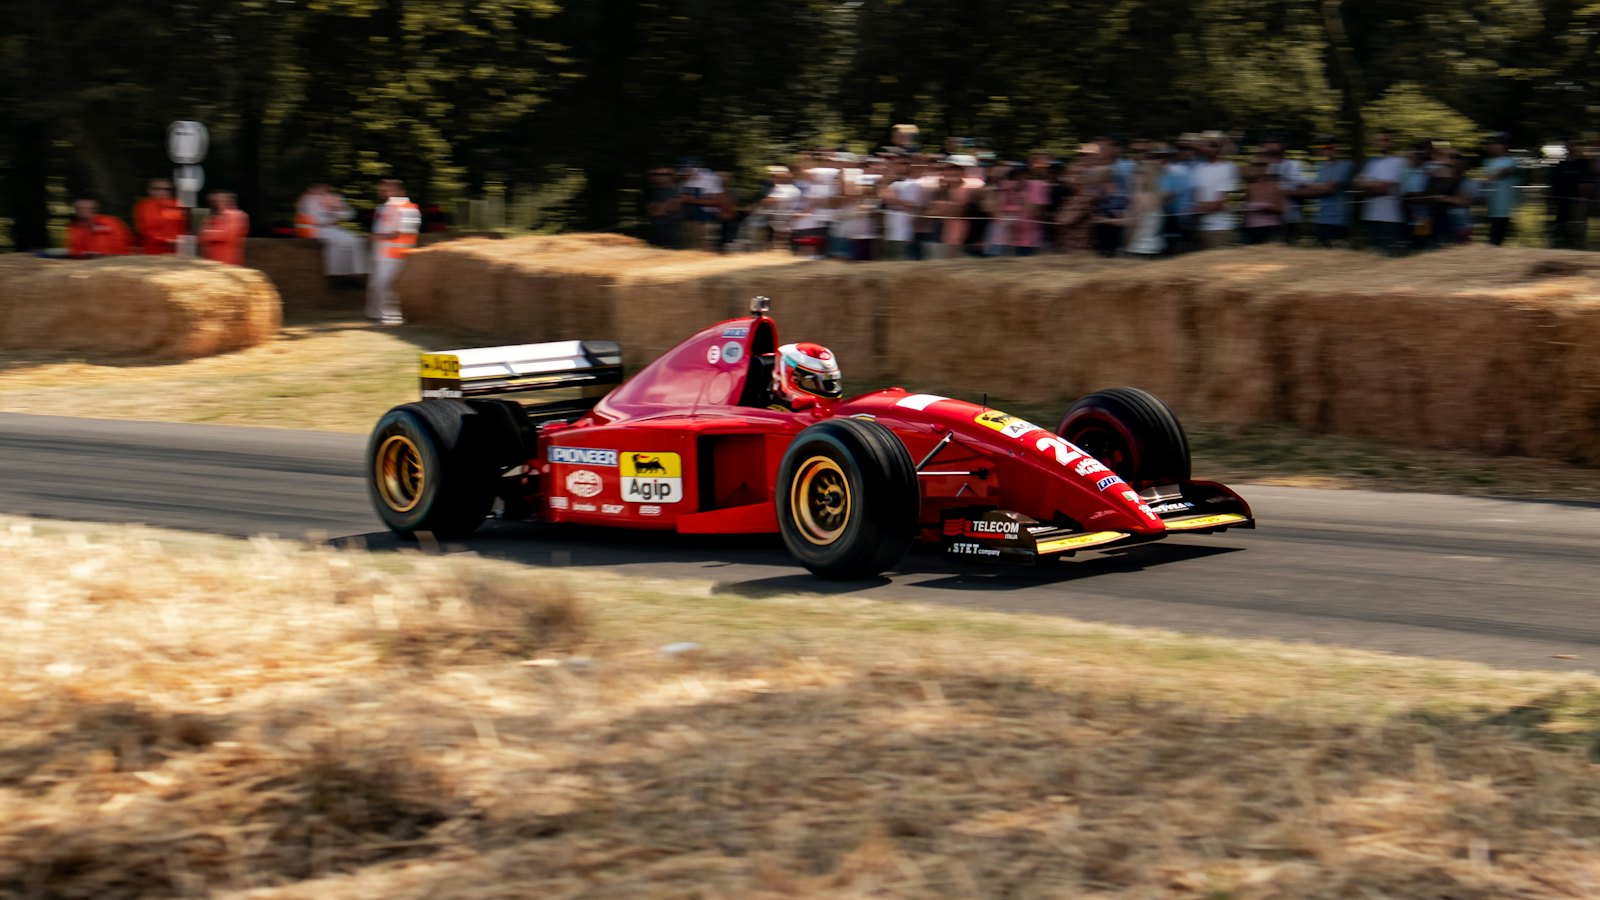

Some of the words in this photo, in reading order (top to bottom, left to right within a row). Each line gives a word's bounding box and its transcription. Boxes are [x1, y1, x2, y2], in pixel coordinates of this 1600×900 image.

[552, 448, 618, 465] PIONEER
[629, 479, 672, 500] Agip
[973, 521, 1019, 533] TELECOM
[952, 543, 979, 554] STET
